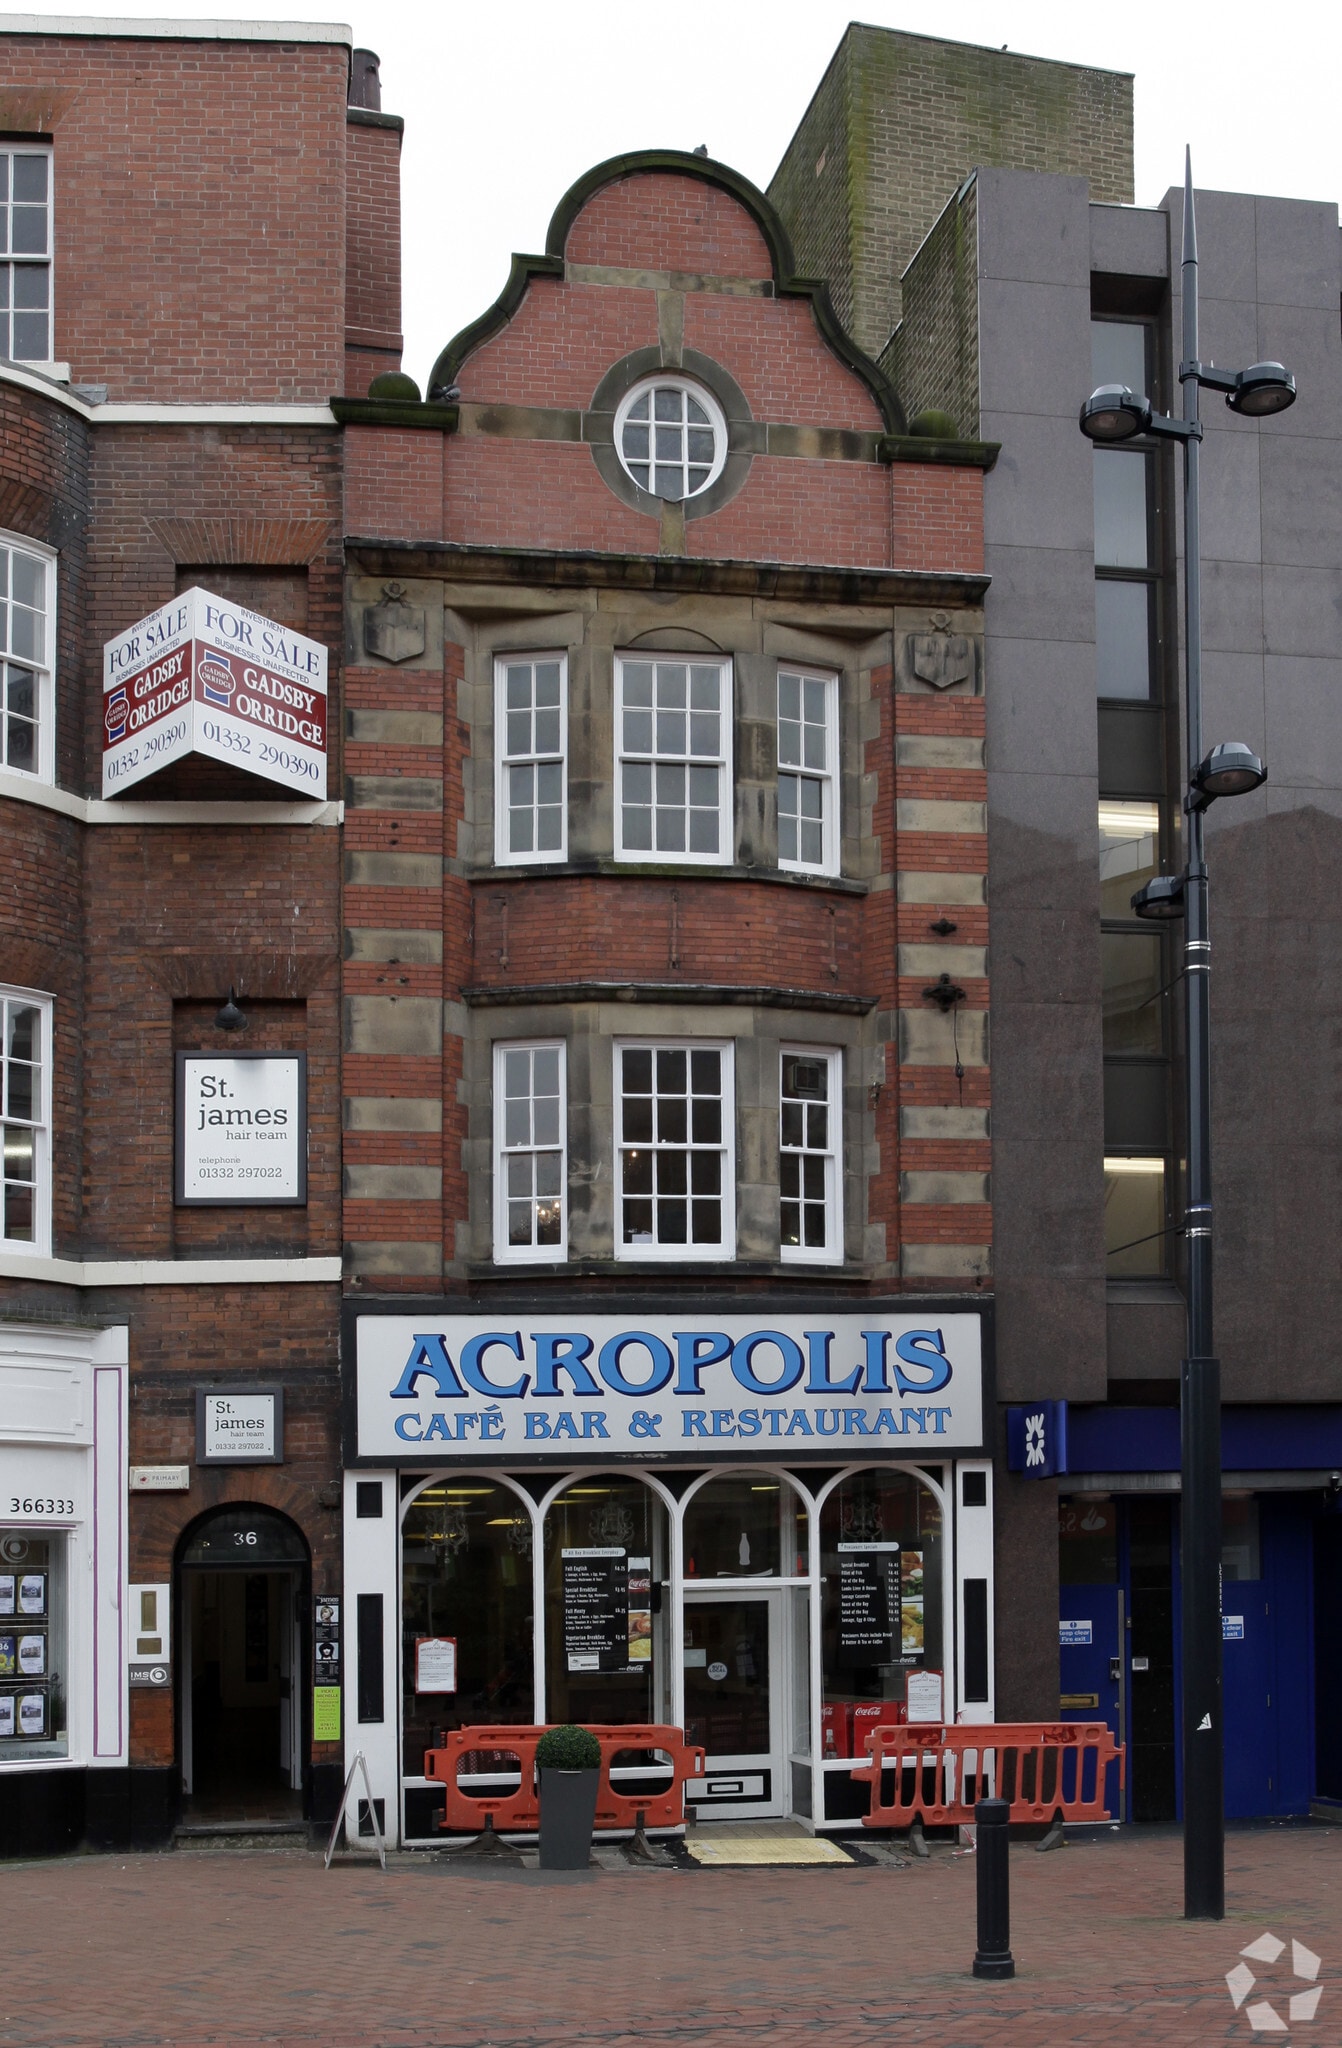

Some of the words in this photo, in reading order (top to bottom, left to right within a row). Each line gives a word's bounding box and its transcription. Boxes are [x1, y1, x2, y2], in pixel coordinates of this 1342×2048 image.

[132, 608, 164, 634] INVESTMENT
[240, 609, 286, 636] INVESTMENT
[110, 636, 141, 674] FOR
[146, 605, 188, 652] SALE
[204, 604, 254, 648] FOR
[262, 632, 320, 676] SALE
[115, 659, 146, 683] BUSINESSES
[146, 637, 180, 664] UNAFFECTED
[204, 664, 230, 681] GADSBY
[214, 636, 260, 663] BUSINESSES
[262, 658, 310, 684] UNAFFECTED
[134, 650, 185, 698] GADSBY
[202, 672, 232, 690] ORRIDGE
[129, 678, 190, 730] ORRIDGE
[243, 668, 316, 714] GADSBY
[107, 708, 128, 725] ORRIDGE
[108, 702, 126, 718] GADSBY
[236, 694, 323, 746] ORRIDGE
[108, 748, 139, 781] 01332
[144, 720, 186, 761] 290390
[203, 720, 251, 755] 01332
[258, 742, 320, 781] 290390
[200, 1075, 234, 1098] St.
[198, 1104, 288, 1130] james
[226, 1130, 251, 1140] hair
[255, 1131, 288, 1140] team
[198, 1156, 240, 1165] telephone
[199, 1168, 234, 1178] 01332
[238, 1167, 282, 1178] 297022
[389, 1328, 954, 1399] ACROPOLIS
[216, 1400, 235, 1414] St.
[214, 1416, 265, 1432] james
[393, 1404, 506, 1442] CAFÉ
[524, 1410, 611, 1442] BAR
[628, 1409, 663, 1439] &
[681, 1405, 953, 1439] RESTAURANT
[10, 1498, 74, 1514] 366333
[234, 1532, 257, 1545] 36
